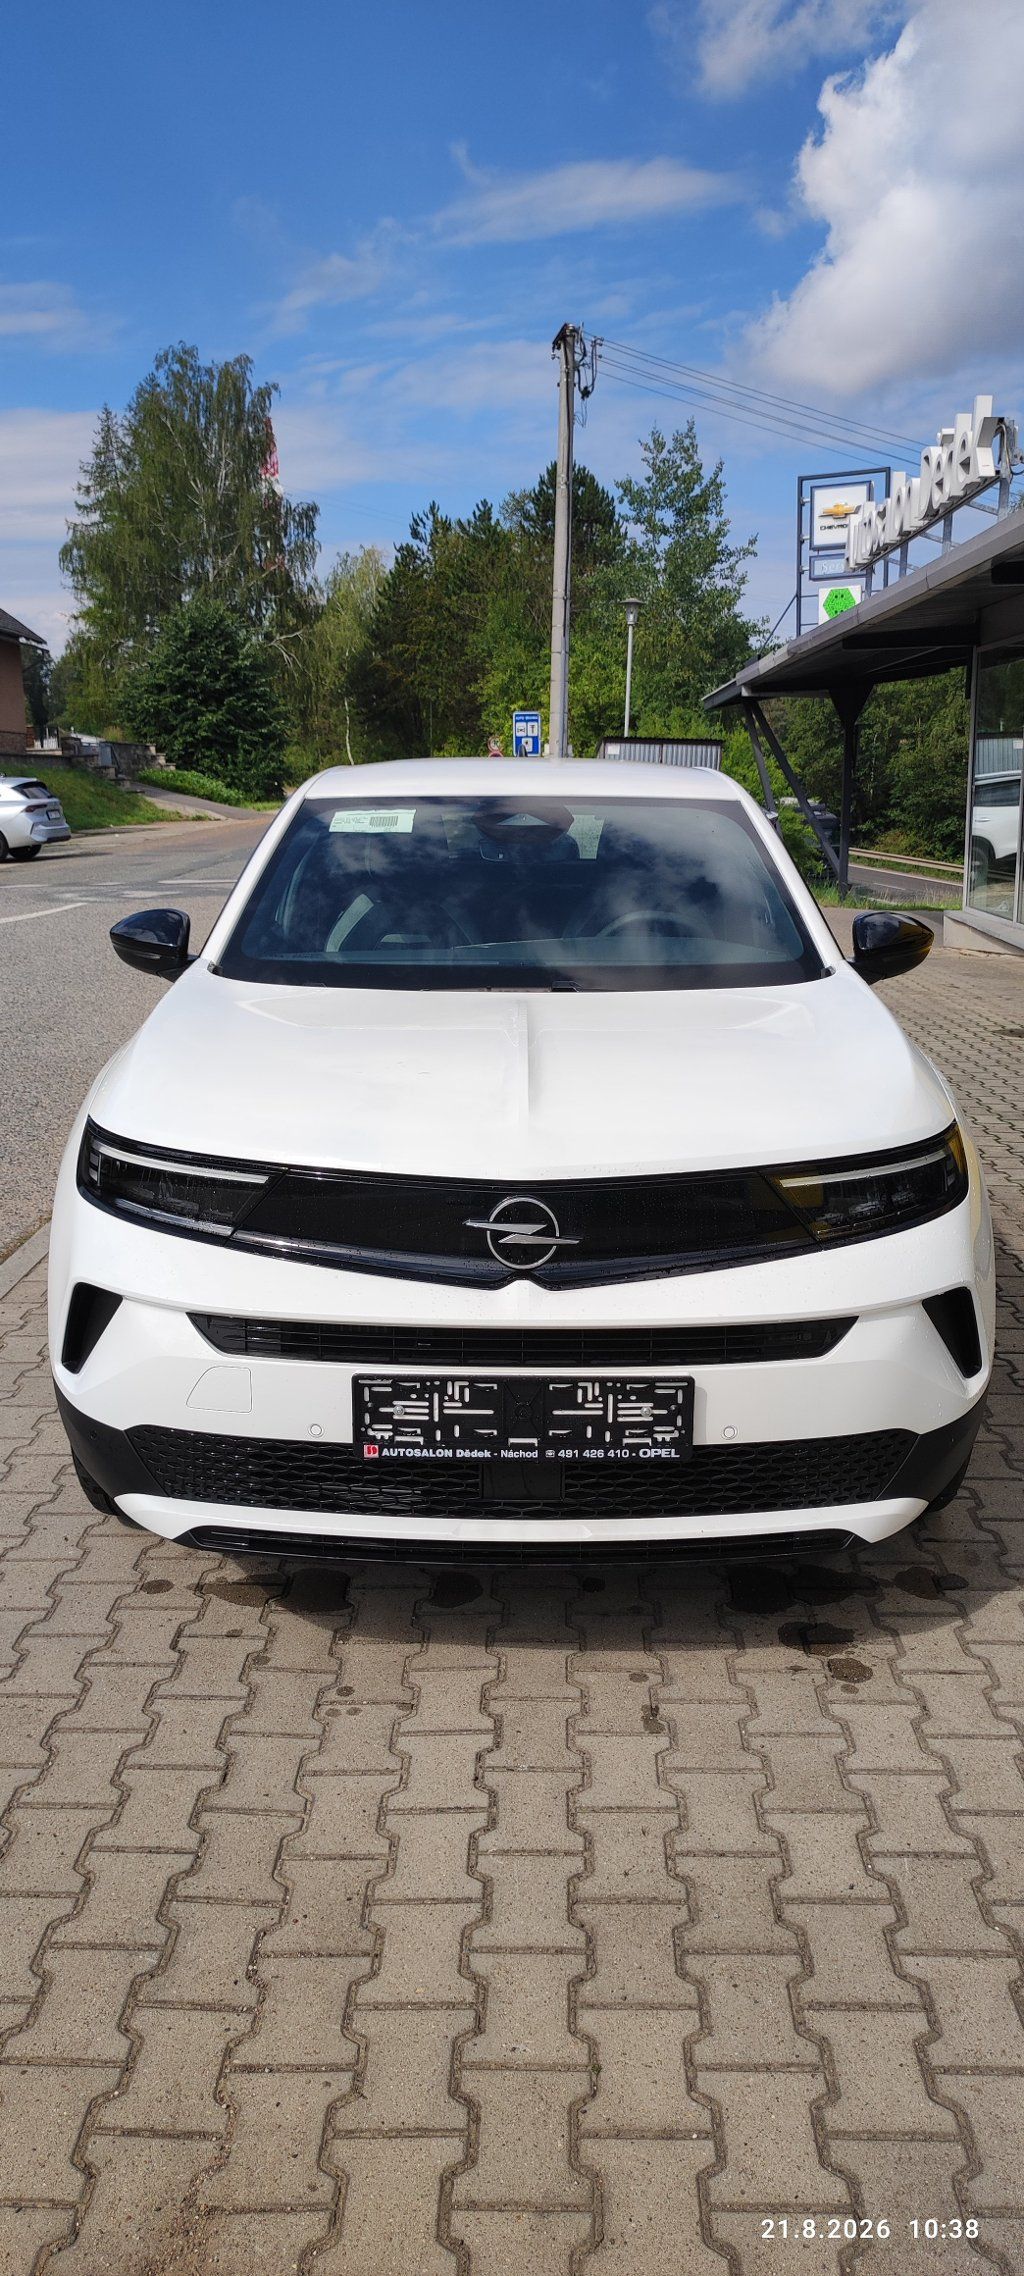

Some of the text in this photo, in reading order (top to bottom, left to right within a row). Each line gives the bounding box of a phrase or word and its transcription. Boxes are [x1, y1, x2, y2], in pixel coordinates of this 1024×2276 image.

[819, 523, 849, 532] CHEVRO
[381, 1448, 453, 1458] AUTOSALON
[456, 1448, 492, 1458] Dědek
[500, 1448, 539, 1459] Náchod
[557, 1449, 579, 1458] 491
[582, 1449, 605, 1458] 426
[607, 1449, 630, 1458] 410
[638, 1448, 681, 1458] OPEL
